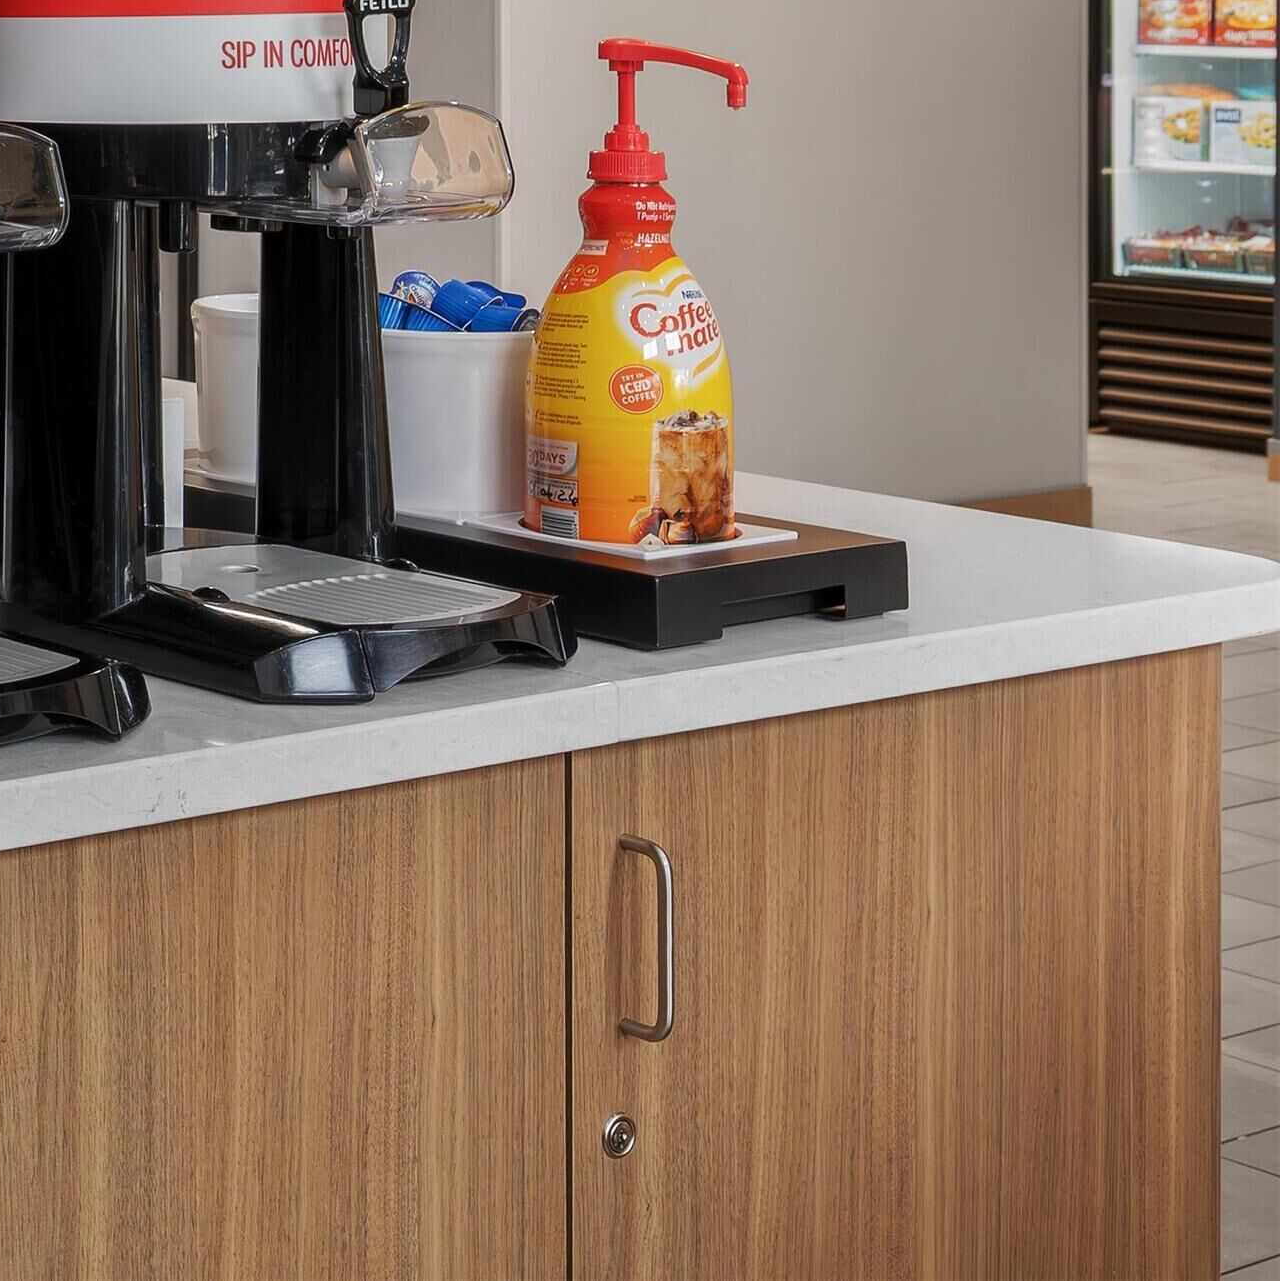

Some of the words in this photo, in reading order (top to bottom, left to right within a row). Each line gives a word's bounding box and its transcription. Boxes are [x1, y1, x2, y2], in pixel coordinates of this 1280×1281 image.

[221, 40, 256, 69] SIP
[264, 40, 284, 68] IN
[290, 38, 354, 68] COMFO
[629, 301, 714, 338] Coffee
[622, 391, 657, 405] COFFEE
[539, 451, 566, 465] DAYS
